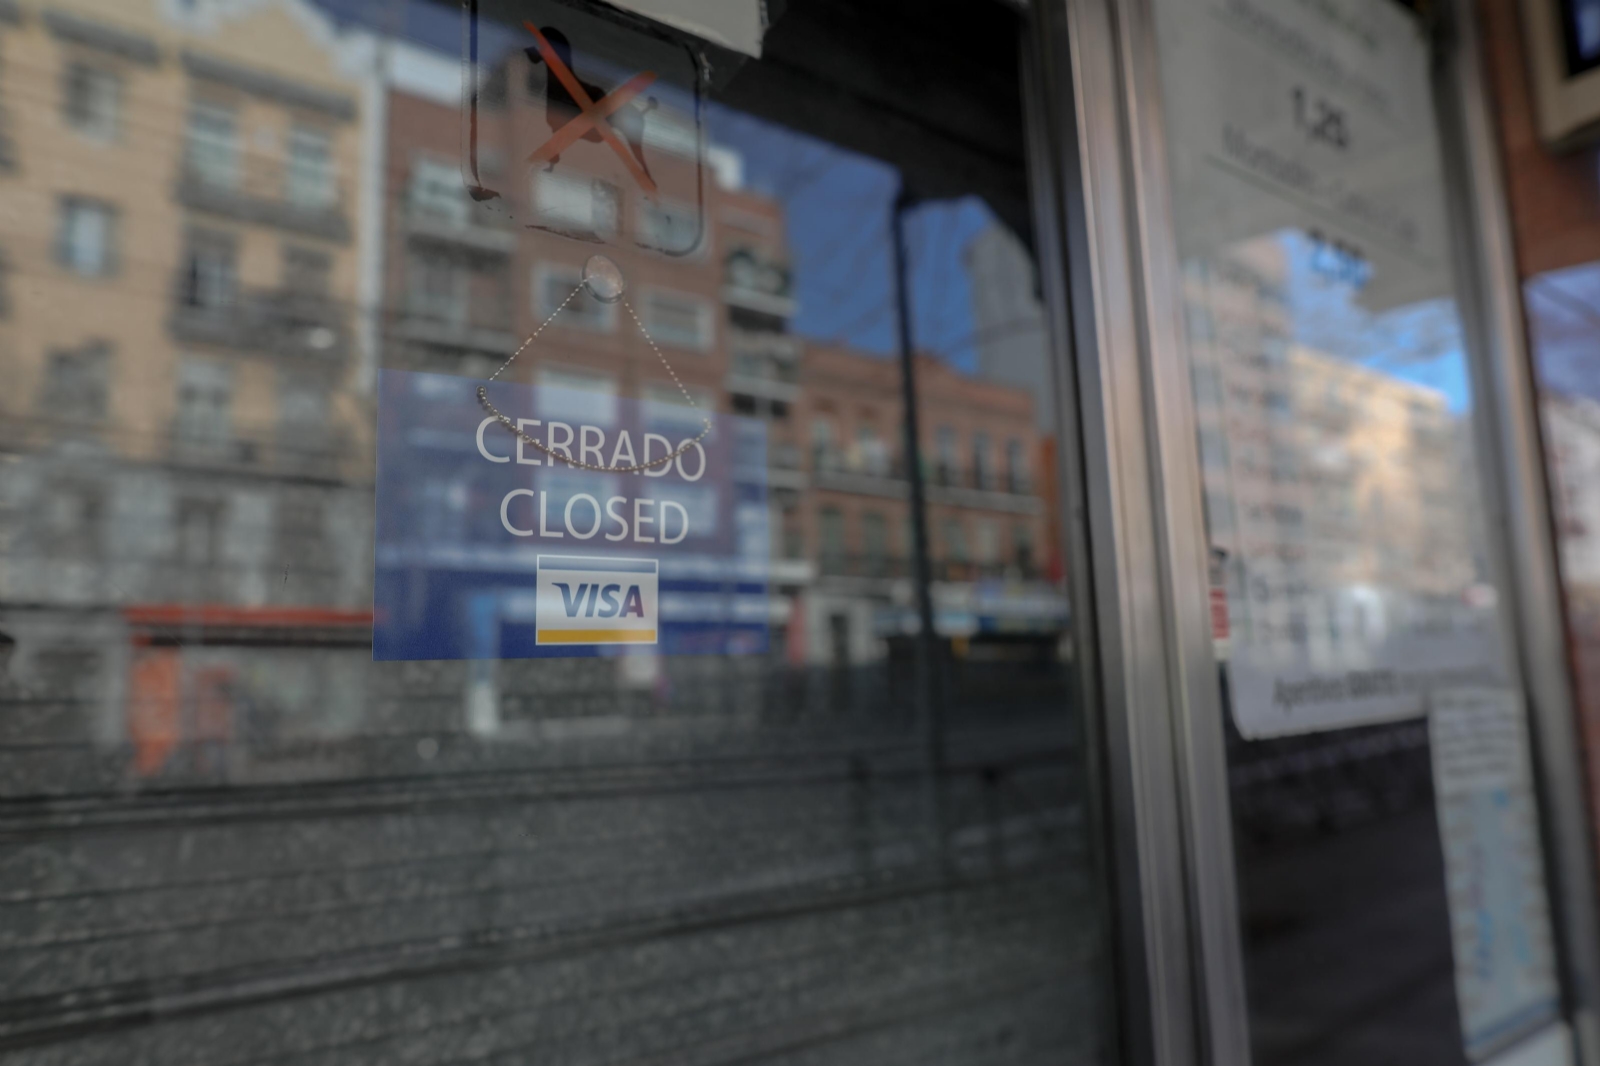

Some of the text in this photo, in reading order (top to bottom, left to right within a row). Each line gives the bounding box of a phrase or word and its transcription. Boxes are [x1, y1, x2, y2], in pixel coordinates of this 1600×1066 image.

[476, 416, 706, 481] CERRADO
[500, 489, 689, 544] CLOSED
[551, 582, 644, 618] VISA
